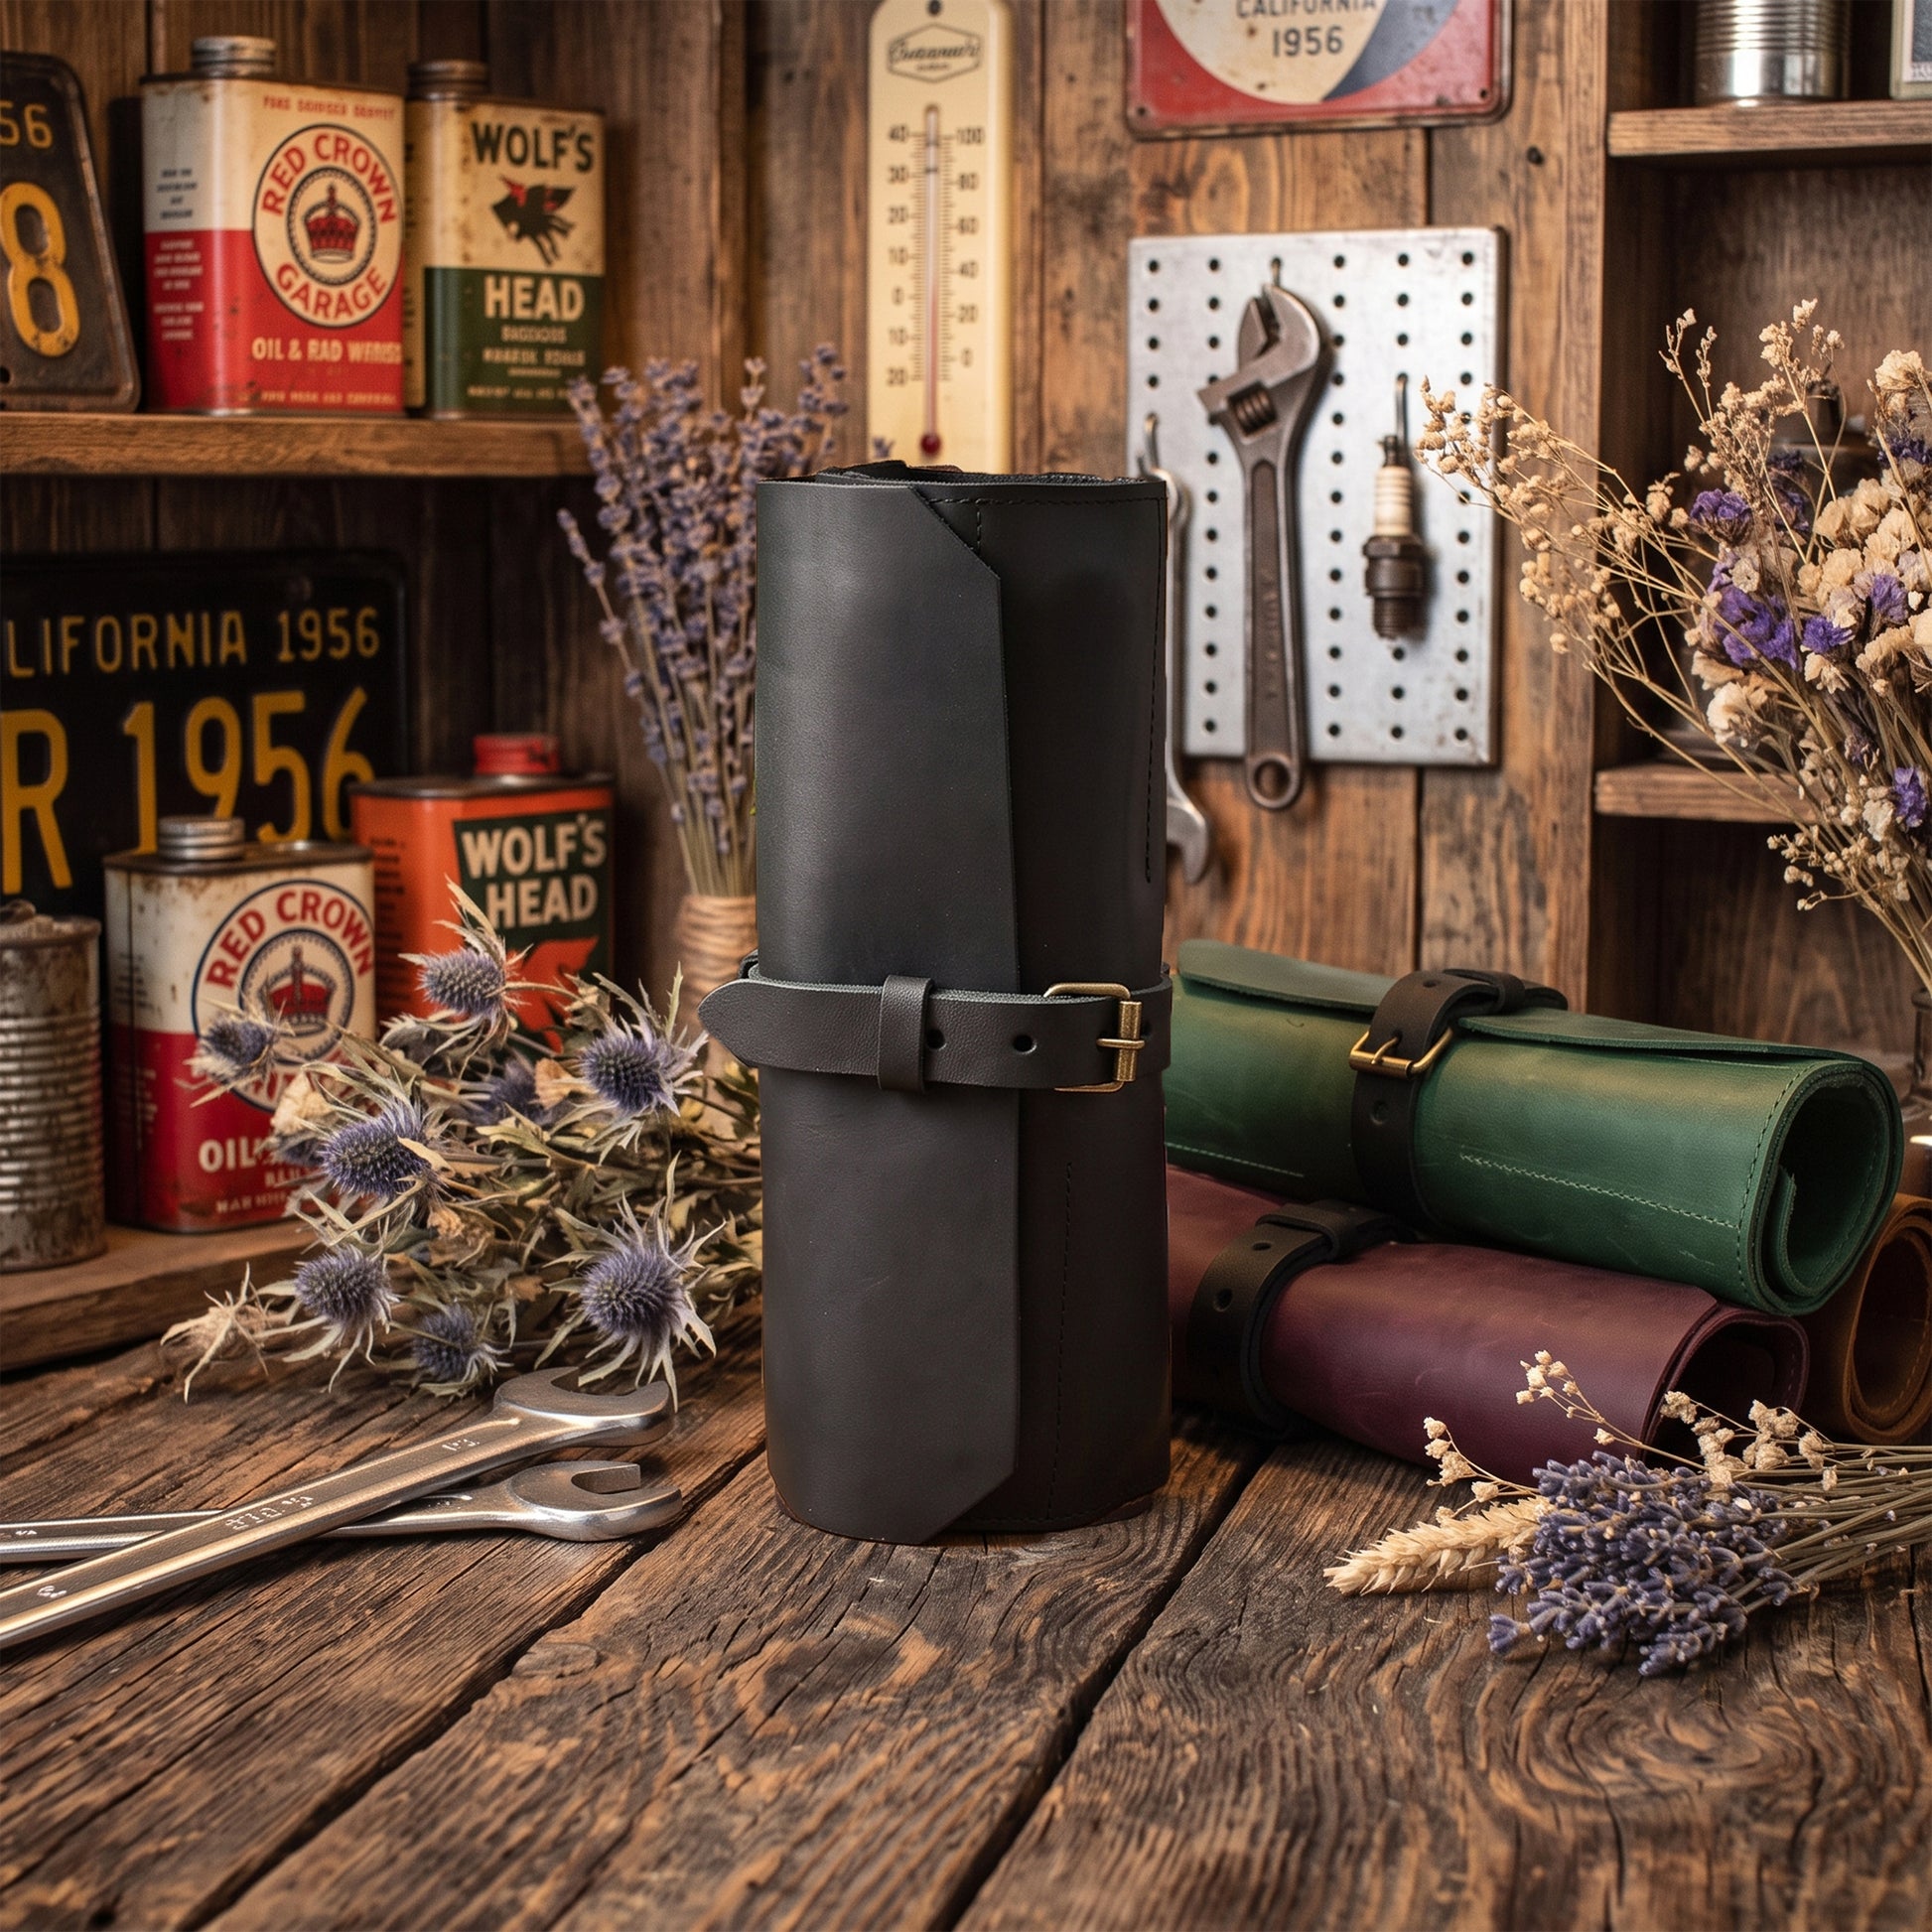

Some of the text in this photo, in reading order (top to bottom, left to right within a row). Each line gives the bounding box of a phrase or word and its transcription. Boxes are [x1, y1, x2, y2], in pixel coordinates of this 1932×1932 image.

[1273, 25, 1343, 57] 1956
[472, 121, 594, 174] WOLF'S
[889, 124, 908, 142] 40
[957, 127, 984, 144] 100
[260, 147, 306, 215] RED
[314, 133, 397, 224] CROWN
[889, 206, 907, 223] 20
[0, 182, 80, 357] 8
[276, 263, 387, 321] GARAGE
[959, 260, 979, 278] 40
[483, 274, 586, 322] HEAD
[958, 304, 979, 323] 20
[251, 337, 284, 361] OIL
[288, 339, 302, 361] &
[887, 367, 907, 386] 20
[7, 607, 380, 678] LIFORNIA 1956
[122, 687, 376, 856] 1956
[461, 813, 608, 880] WOLF'S
[485, 873, 598, 930] HEAD
[205, 908, 266, 989] RED
[275, 891, 373, 978] CROWN
[199, 1137, 256, 1173] OIL
